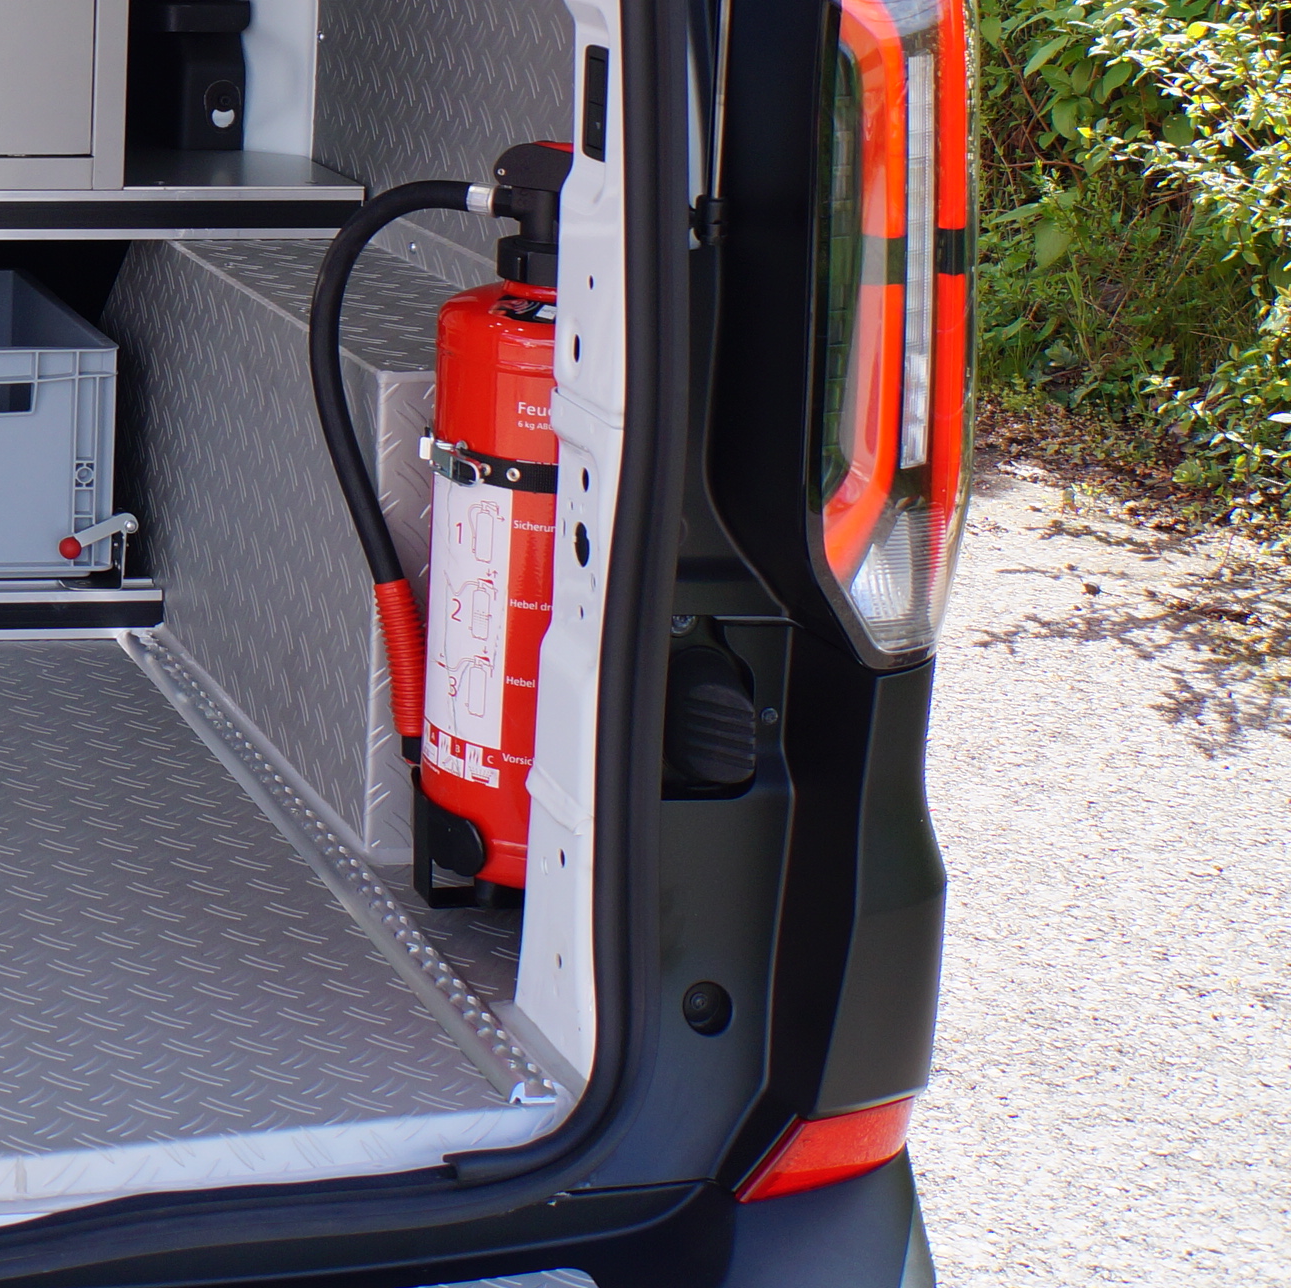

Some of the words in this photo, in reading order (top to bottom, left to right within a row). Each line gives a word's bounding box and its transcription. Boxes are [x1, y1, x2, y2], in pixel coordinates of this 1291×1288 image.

[517, 420, 523, 428] 6
[524, 421, 535, 431] kg
[455, 522, 462, 544] 1
[451, 598, 461, 622] 2
[509, 598, 538, 611] Hebel
[506, 675, 536, 689] Hebel
[486, 755, 494, 764] C
[501, 751, 535, 767] Vorsic
